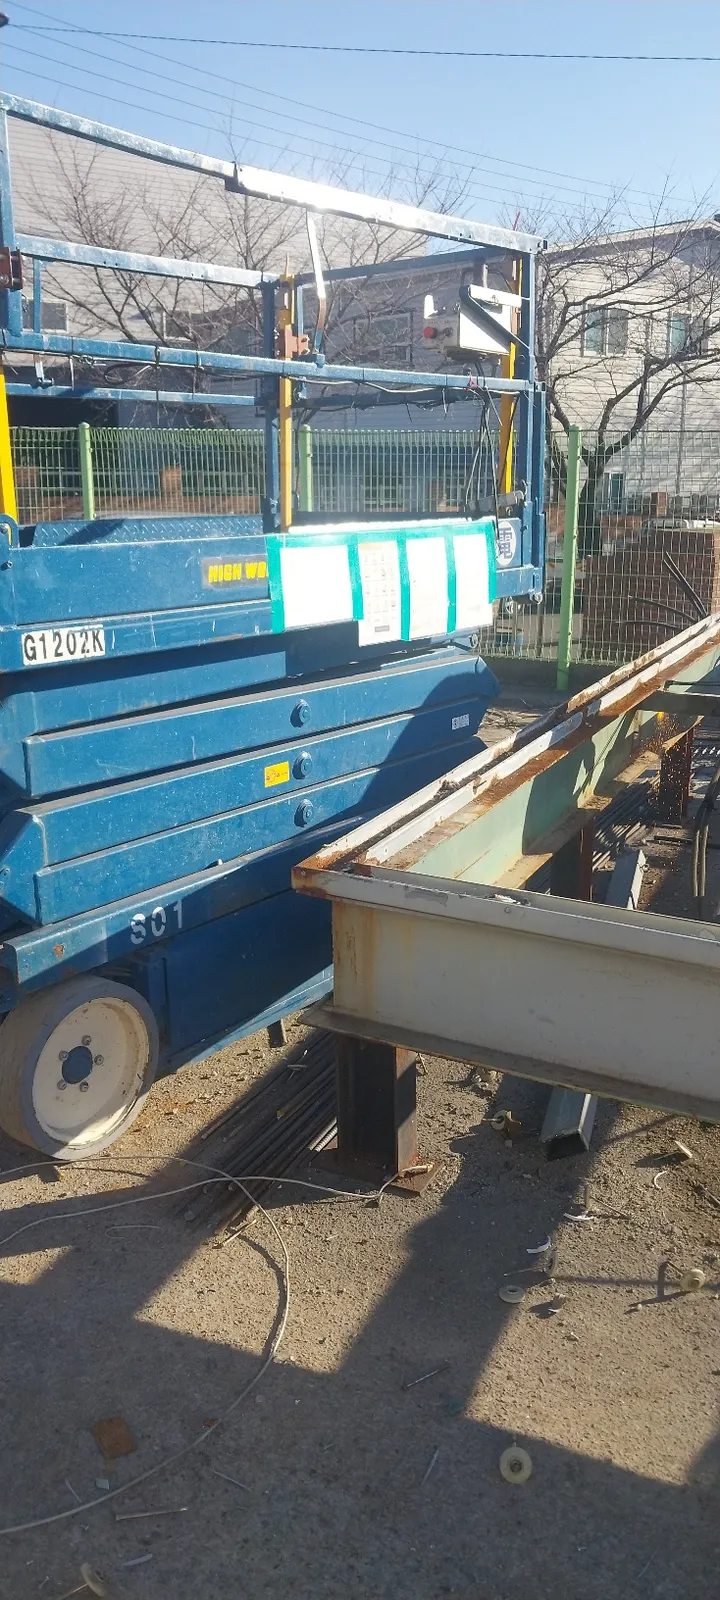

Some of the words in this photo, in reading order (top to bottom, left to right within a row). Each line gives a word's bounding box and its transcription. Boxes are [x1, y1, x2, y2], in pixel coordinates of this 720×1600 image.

[208, 563, 242, 583] HIGH
[245, 561, 268, 579] WO
[23, 629, 104, 662] G1202K
